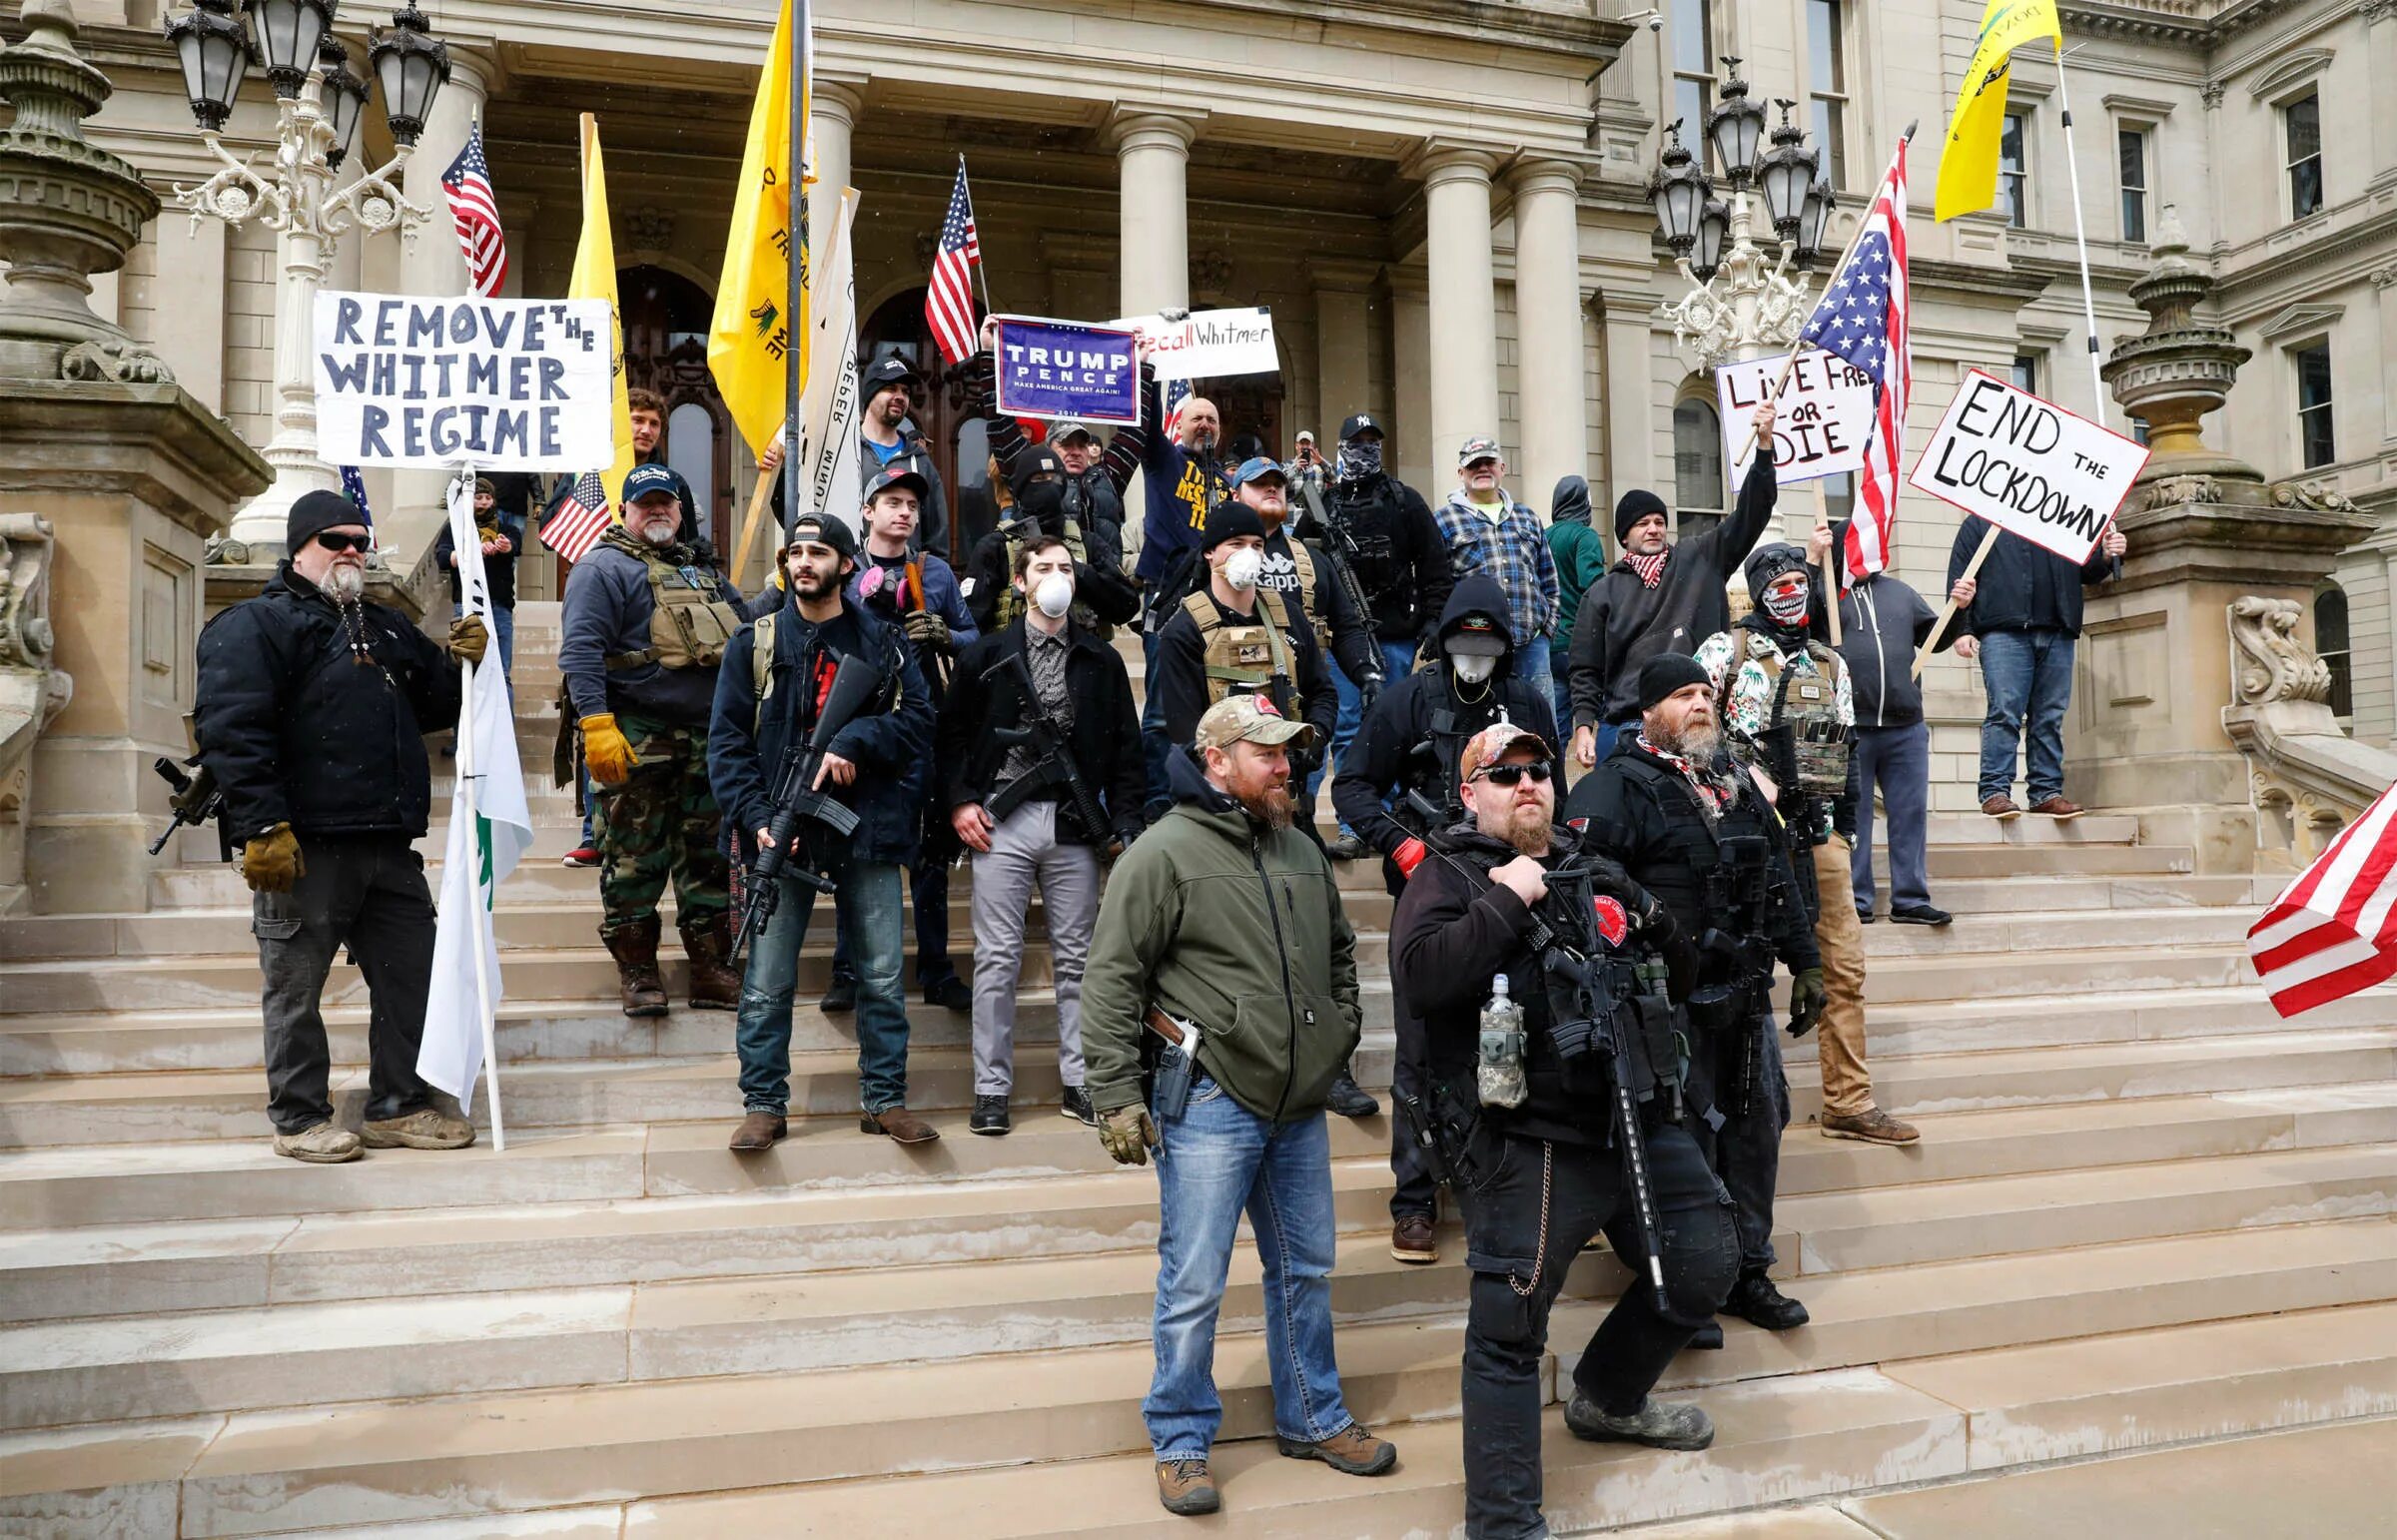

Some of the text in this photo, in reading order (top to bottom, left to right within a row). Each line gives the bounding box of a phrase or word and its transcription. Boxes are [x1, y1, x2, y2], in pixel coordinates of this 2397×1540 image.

[334, 298, 595, 352] REMOVE THE
[1147, 322, 1270, 353] ecall Whitmer
[321, 353, 571, 400] WHITMER
[1006, 345, 1130, 371] TRUMP
[1017, 367, 1118, 385] PENCE
[1036, 383, 1068, 391] AMERICA
[361, 404, 562, 457] REGIME
[1772, 421, 1850, 467] DIE
[1956, 380, 2109, 480] END THE
[1934, 436, 2107, 543] LOCKDOWN
[1255, 570, 1302, 592] Kapp
